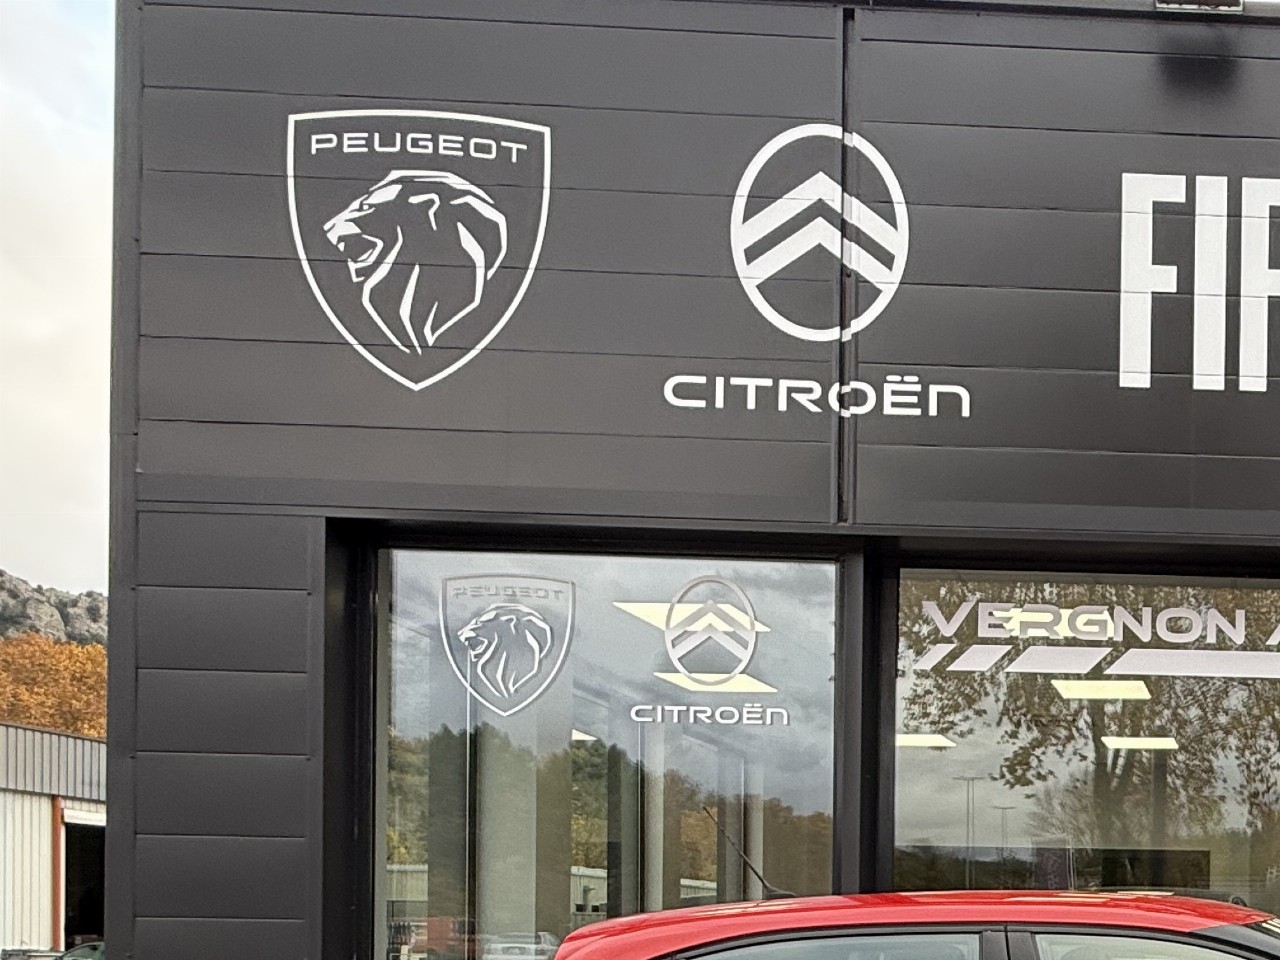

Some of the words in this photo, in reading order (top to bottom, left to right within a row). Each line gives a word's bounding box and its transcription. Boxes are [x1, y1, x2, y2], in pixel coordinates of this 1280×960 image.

[310, 132, 527, 162] PEUGEOT
[453, 585, 563, 600] PEUGEOT
[921, 601, 1245, 644] VERGNON
